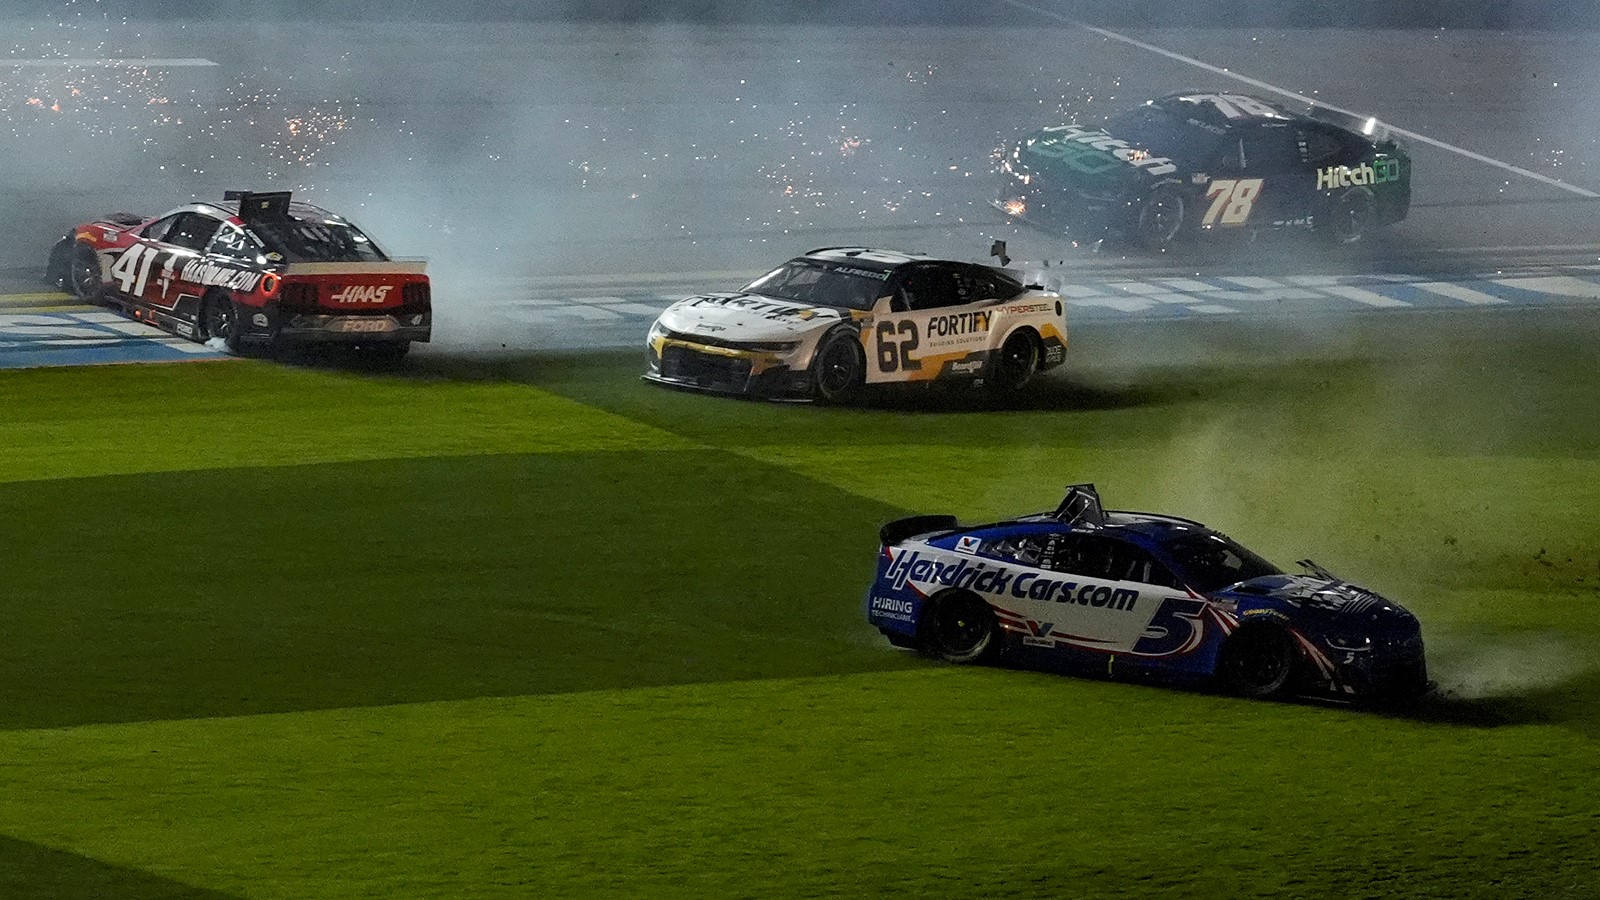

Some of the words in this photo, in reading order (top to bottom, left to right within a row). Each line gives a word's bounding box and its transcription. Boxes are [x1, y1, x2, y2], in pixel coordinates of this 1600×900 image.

[1202, 178, 1264, 225] 78
[111, 243, 159, 297] 41
[331, 285, 395, 303] HAAS
[343, 320, 387, 332] FORD
[928, 310, 993, 338] FORTIFY
[877, 320, 922, 372] 62
[872, 596, 913, 613] HIRING
[1131, 596, 1206, 657] 5
